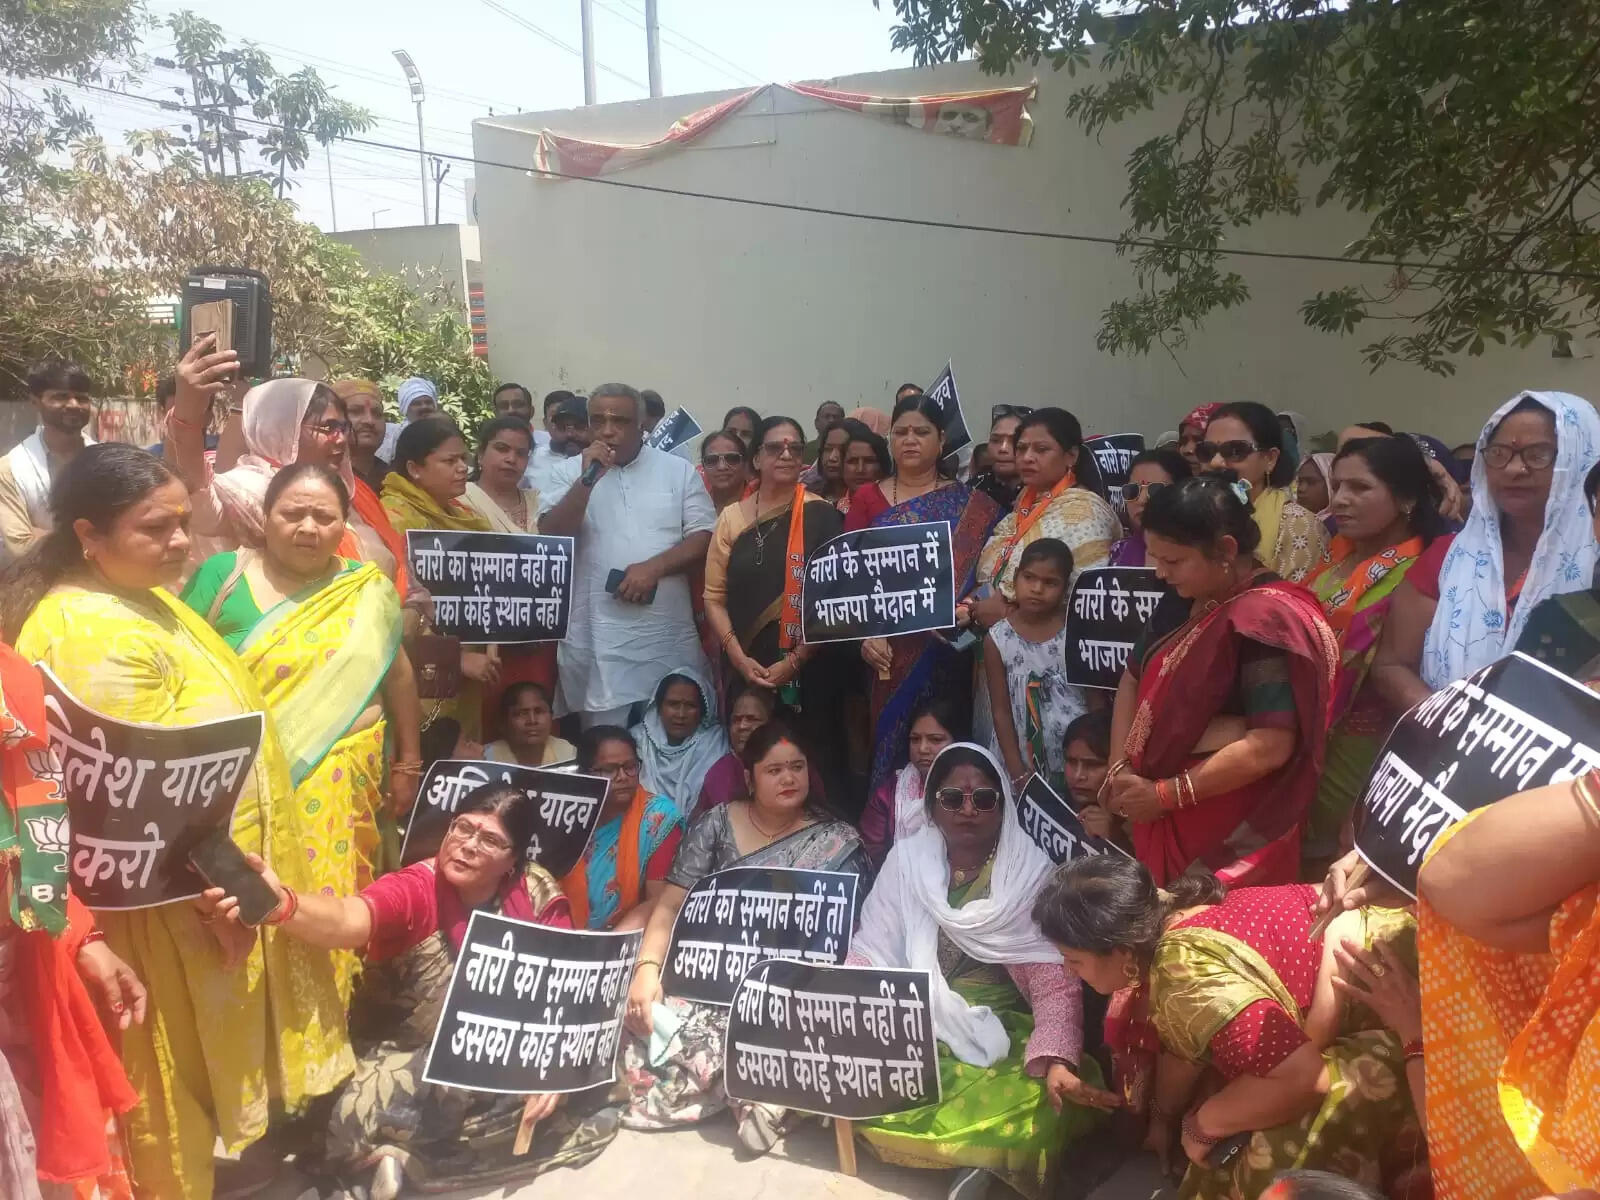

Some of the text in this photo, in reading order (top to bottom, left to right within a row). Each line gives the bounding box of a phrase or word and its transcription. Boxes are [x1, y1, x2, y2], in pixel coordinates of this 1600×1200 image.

[1094, 441, 1120, 474] नारी
[414, 538, 568, 588] नारी का सम्मान नहीं तो
[810, 531, 940, 584] नारी के सम्मान में
[463, 584, 493, 634] कोई
[494, 596, 532, 627] स्थान
[535, 586, 562, 630] नहीं
[815, 577, 937, 626] भाजपा मैदान में
[1074, 576, 1107, 620] नारी
[1109, 577, 1130, 622] के
[1456, 693, 1572, 792] सम्मान
[162, 747, 251, 808] यादव
[1364, 750, 1424, 826] भाजपा
[540, 791, 598, 834] यादव
[73, 822, 166, 890] करो
[684, 878, 848, 938] नारी का सम्मान नहीं तो
[466, 931, 515, 996] नारी
[514, 953, 549, 1002] का
[546, 959, 604, 1004] सम्मान
[674, 940, 724, 982] उसका
[737, 966, 924, 1046] नारी का सम्मान नहीं तो
[452, 1011, 522, 1066] उसका
[519, 1006, 564, 1080] कोई
[559, 1022, 601, 1068] स्थान
[735, 1036, 925, 1104] उसका कोई स्थान नहीं
